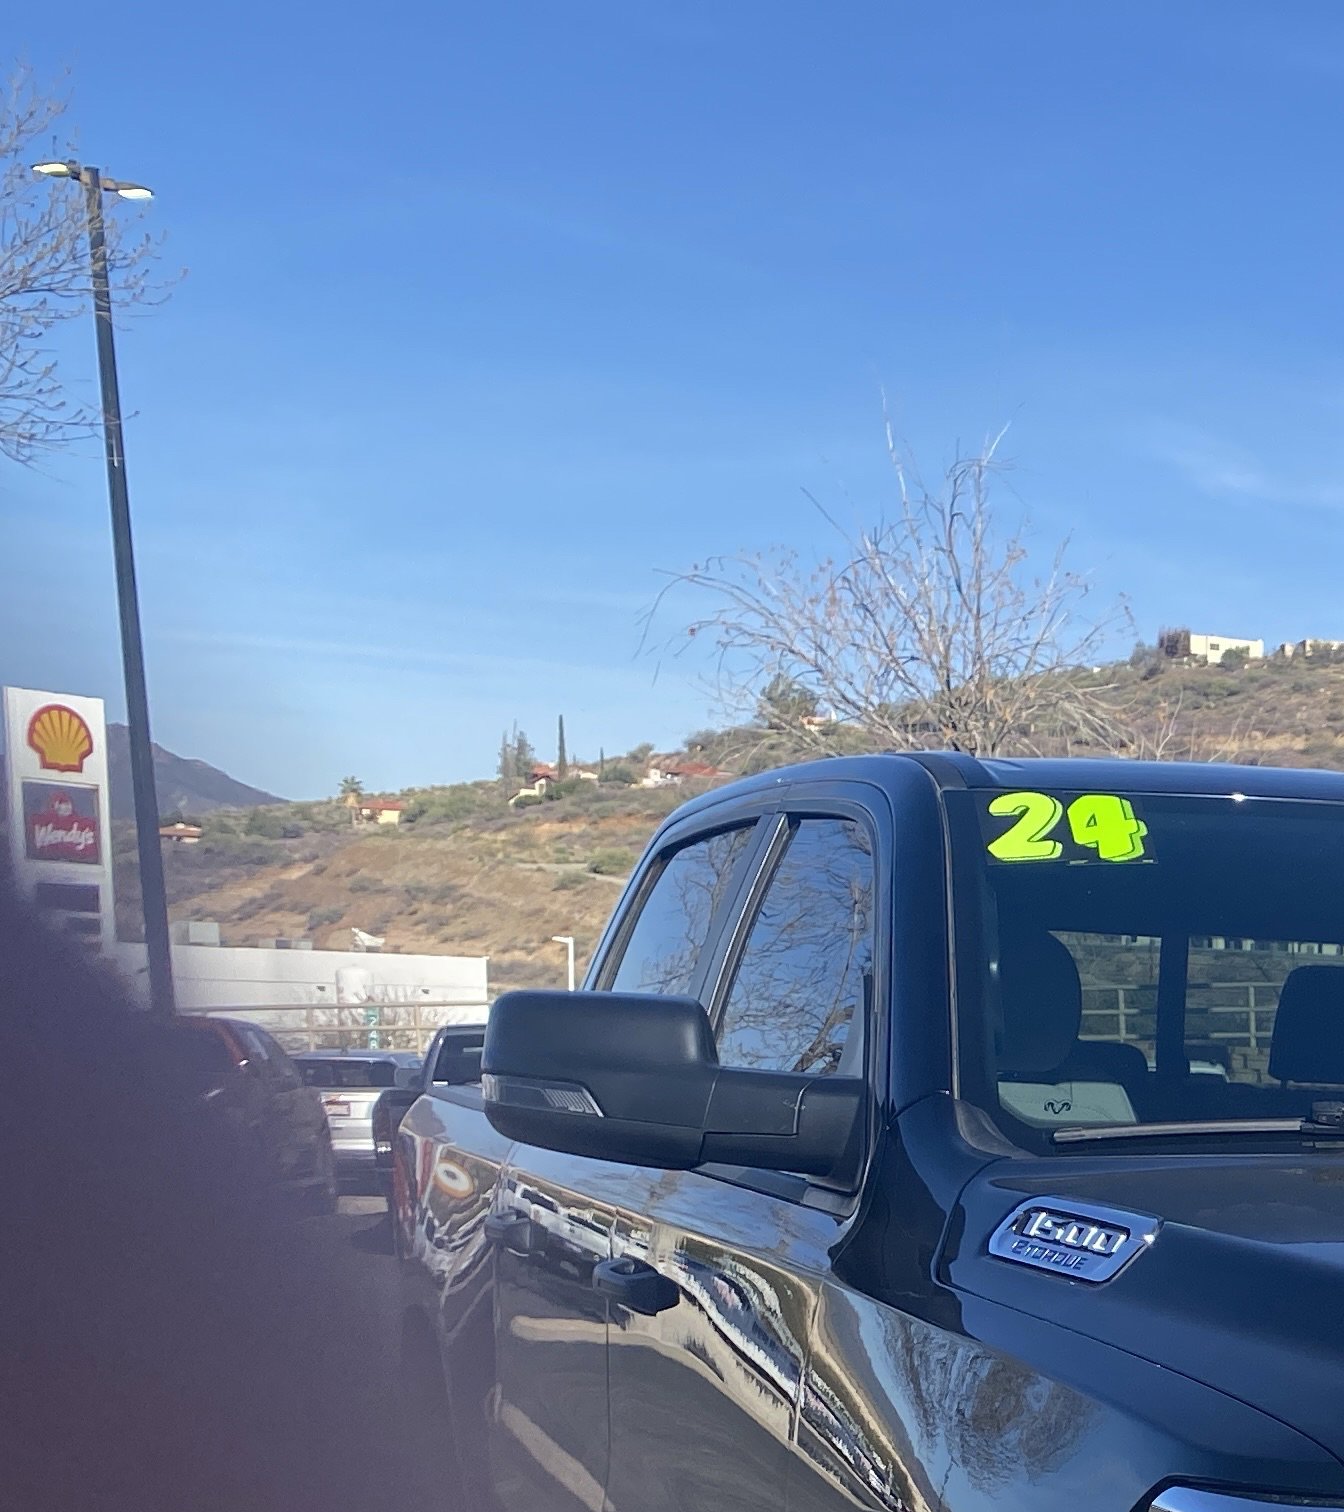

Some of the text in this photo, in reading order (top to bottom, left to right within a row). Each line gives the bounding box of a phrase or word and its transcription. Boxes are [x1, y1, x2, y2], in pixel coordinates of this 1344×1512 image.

[34, 821, 94, 850] Wendy's
[987, 791, 1148, 862] 24
[1016, 1210, 1127, 1253] 1500
